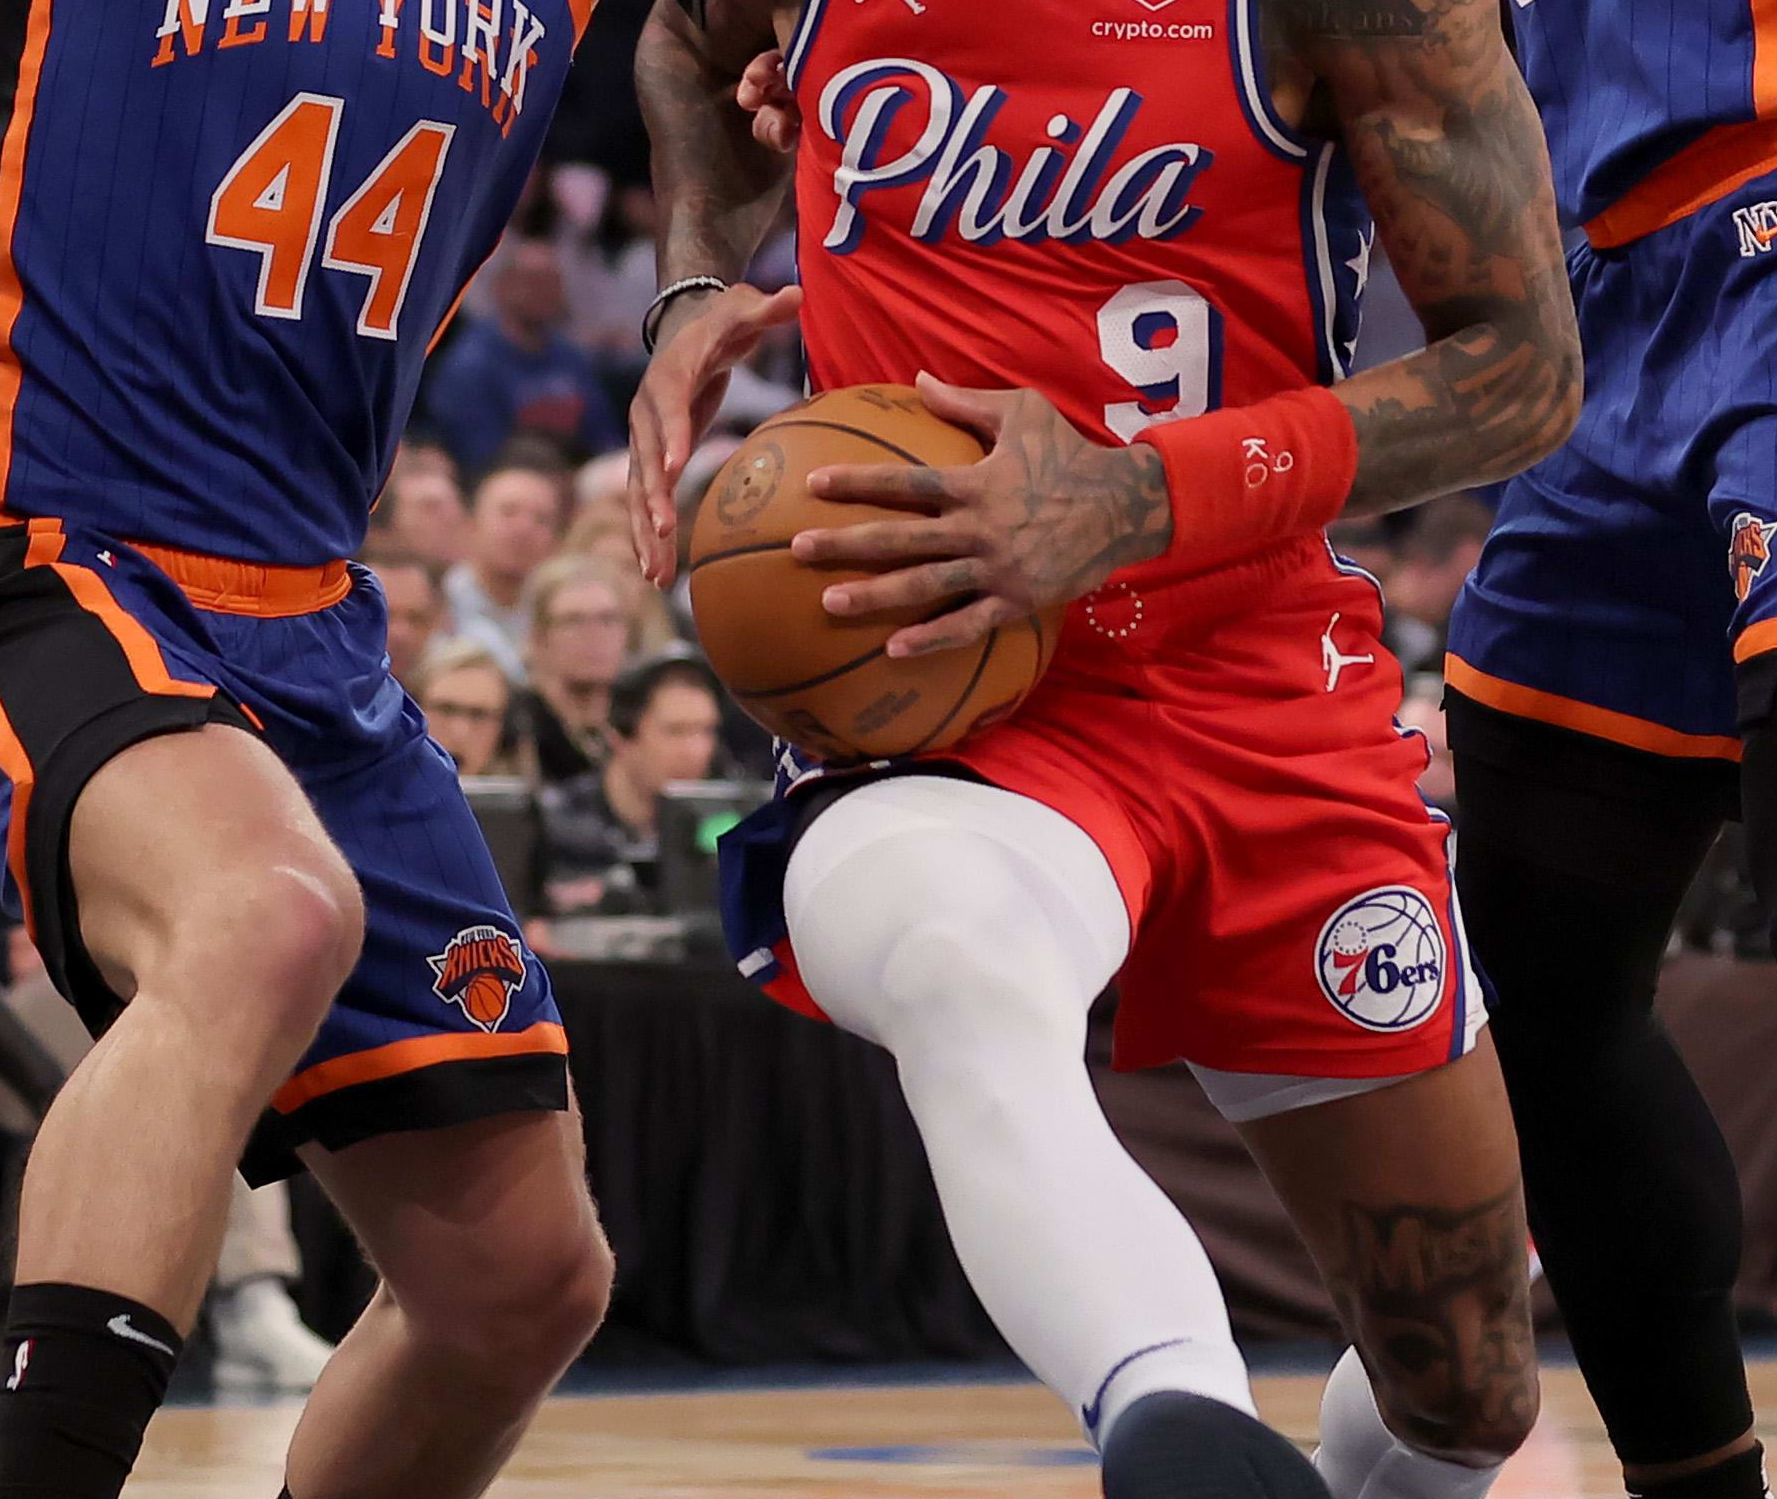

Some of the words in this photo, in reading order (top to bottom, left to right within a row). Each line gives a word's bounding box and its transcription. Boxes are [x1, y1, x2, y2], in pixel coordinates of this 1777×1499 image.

[1091, 19, 1214, 41] crypto.com
[818, 56, 1214, 255] Phila
[205, 91, 458, 342] 44
[1096, 279, 1224, 446] 9
[438, 935, 524, 992] KNICKS
[1333, 943, 1439, 997] 76ers
